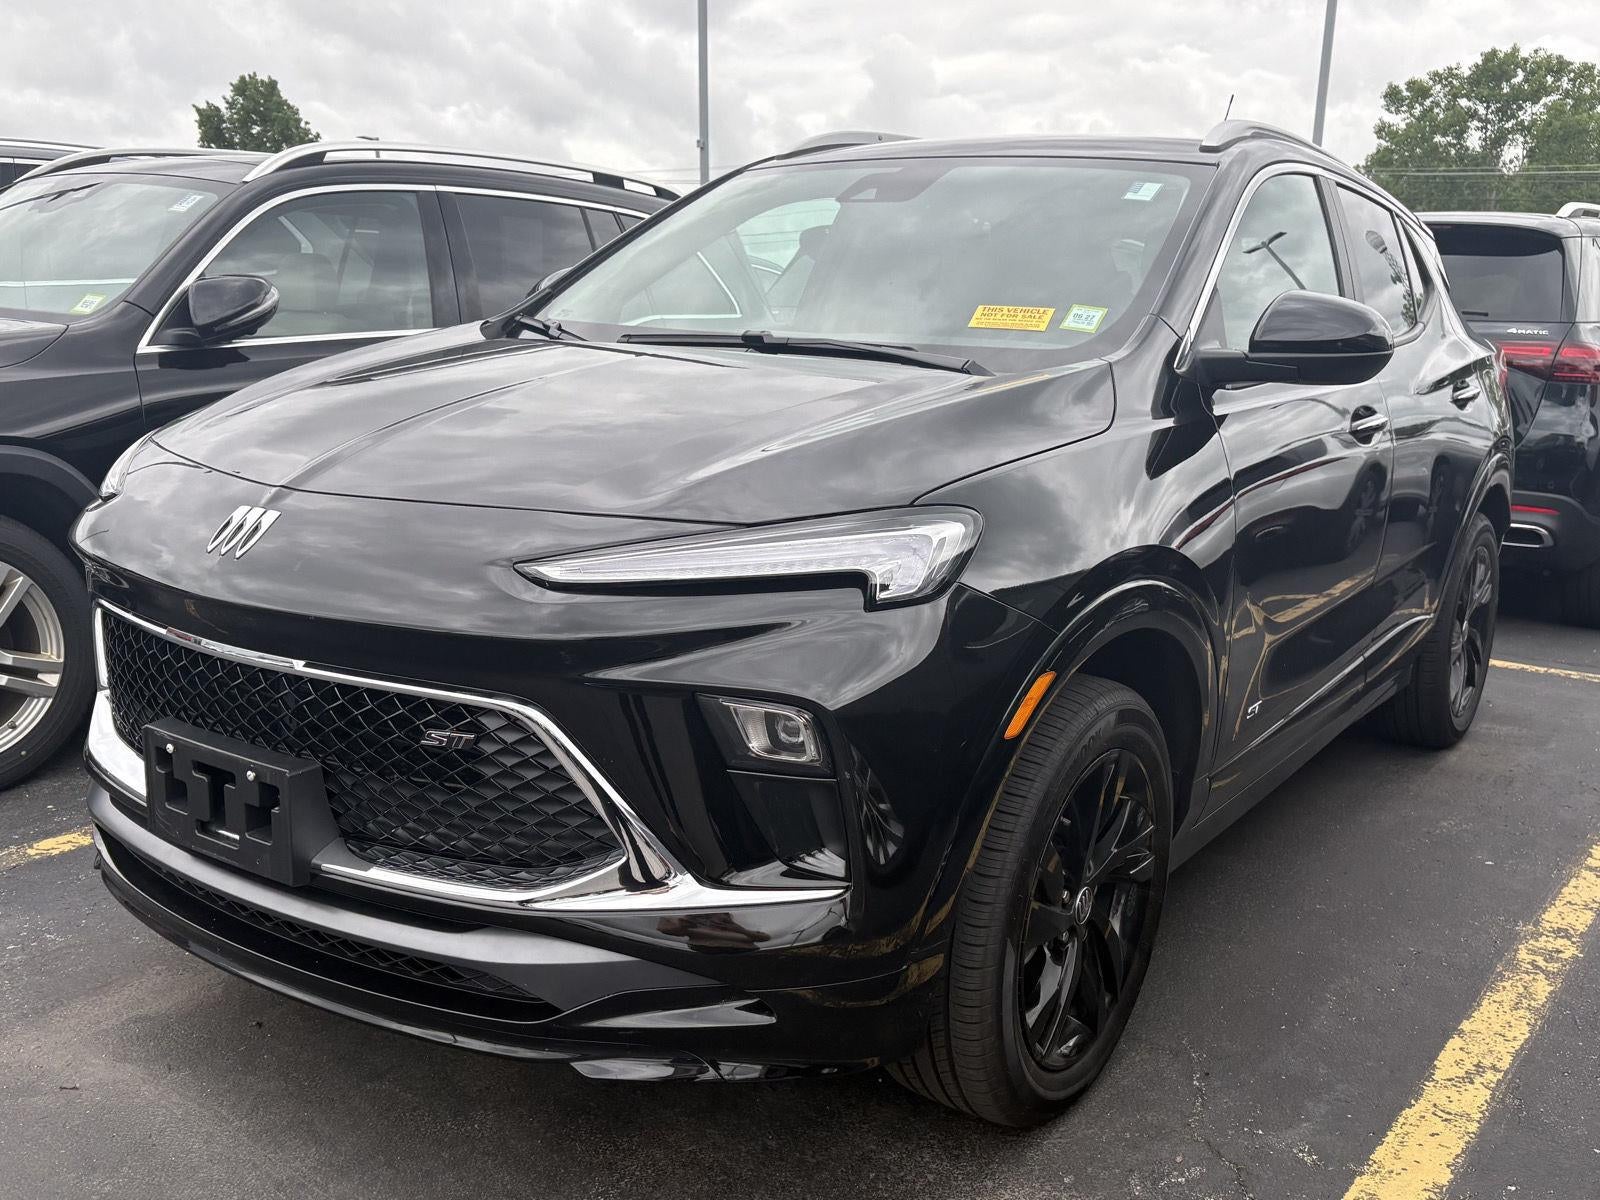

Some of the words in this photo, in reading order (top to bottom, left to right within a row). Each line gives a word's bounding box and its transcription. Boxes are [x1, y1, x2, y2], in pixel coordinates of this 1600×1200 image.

[1007, 307, 1049, 315] VEHICLE
[1506, 327, 1549, 335] 4MATIC
[1246, 699, 1263, 719] ST
[420, 728, 477, 749] ST
